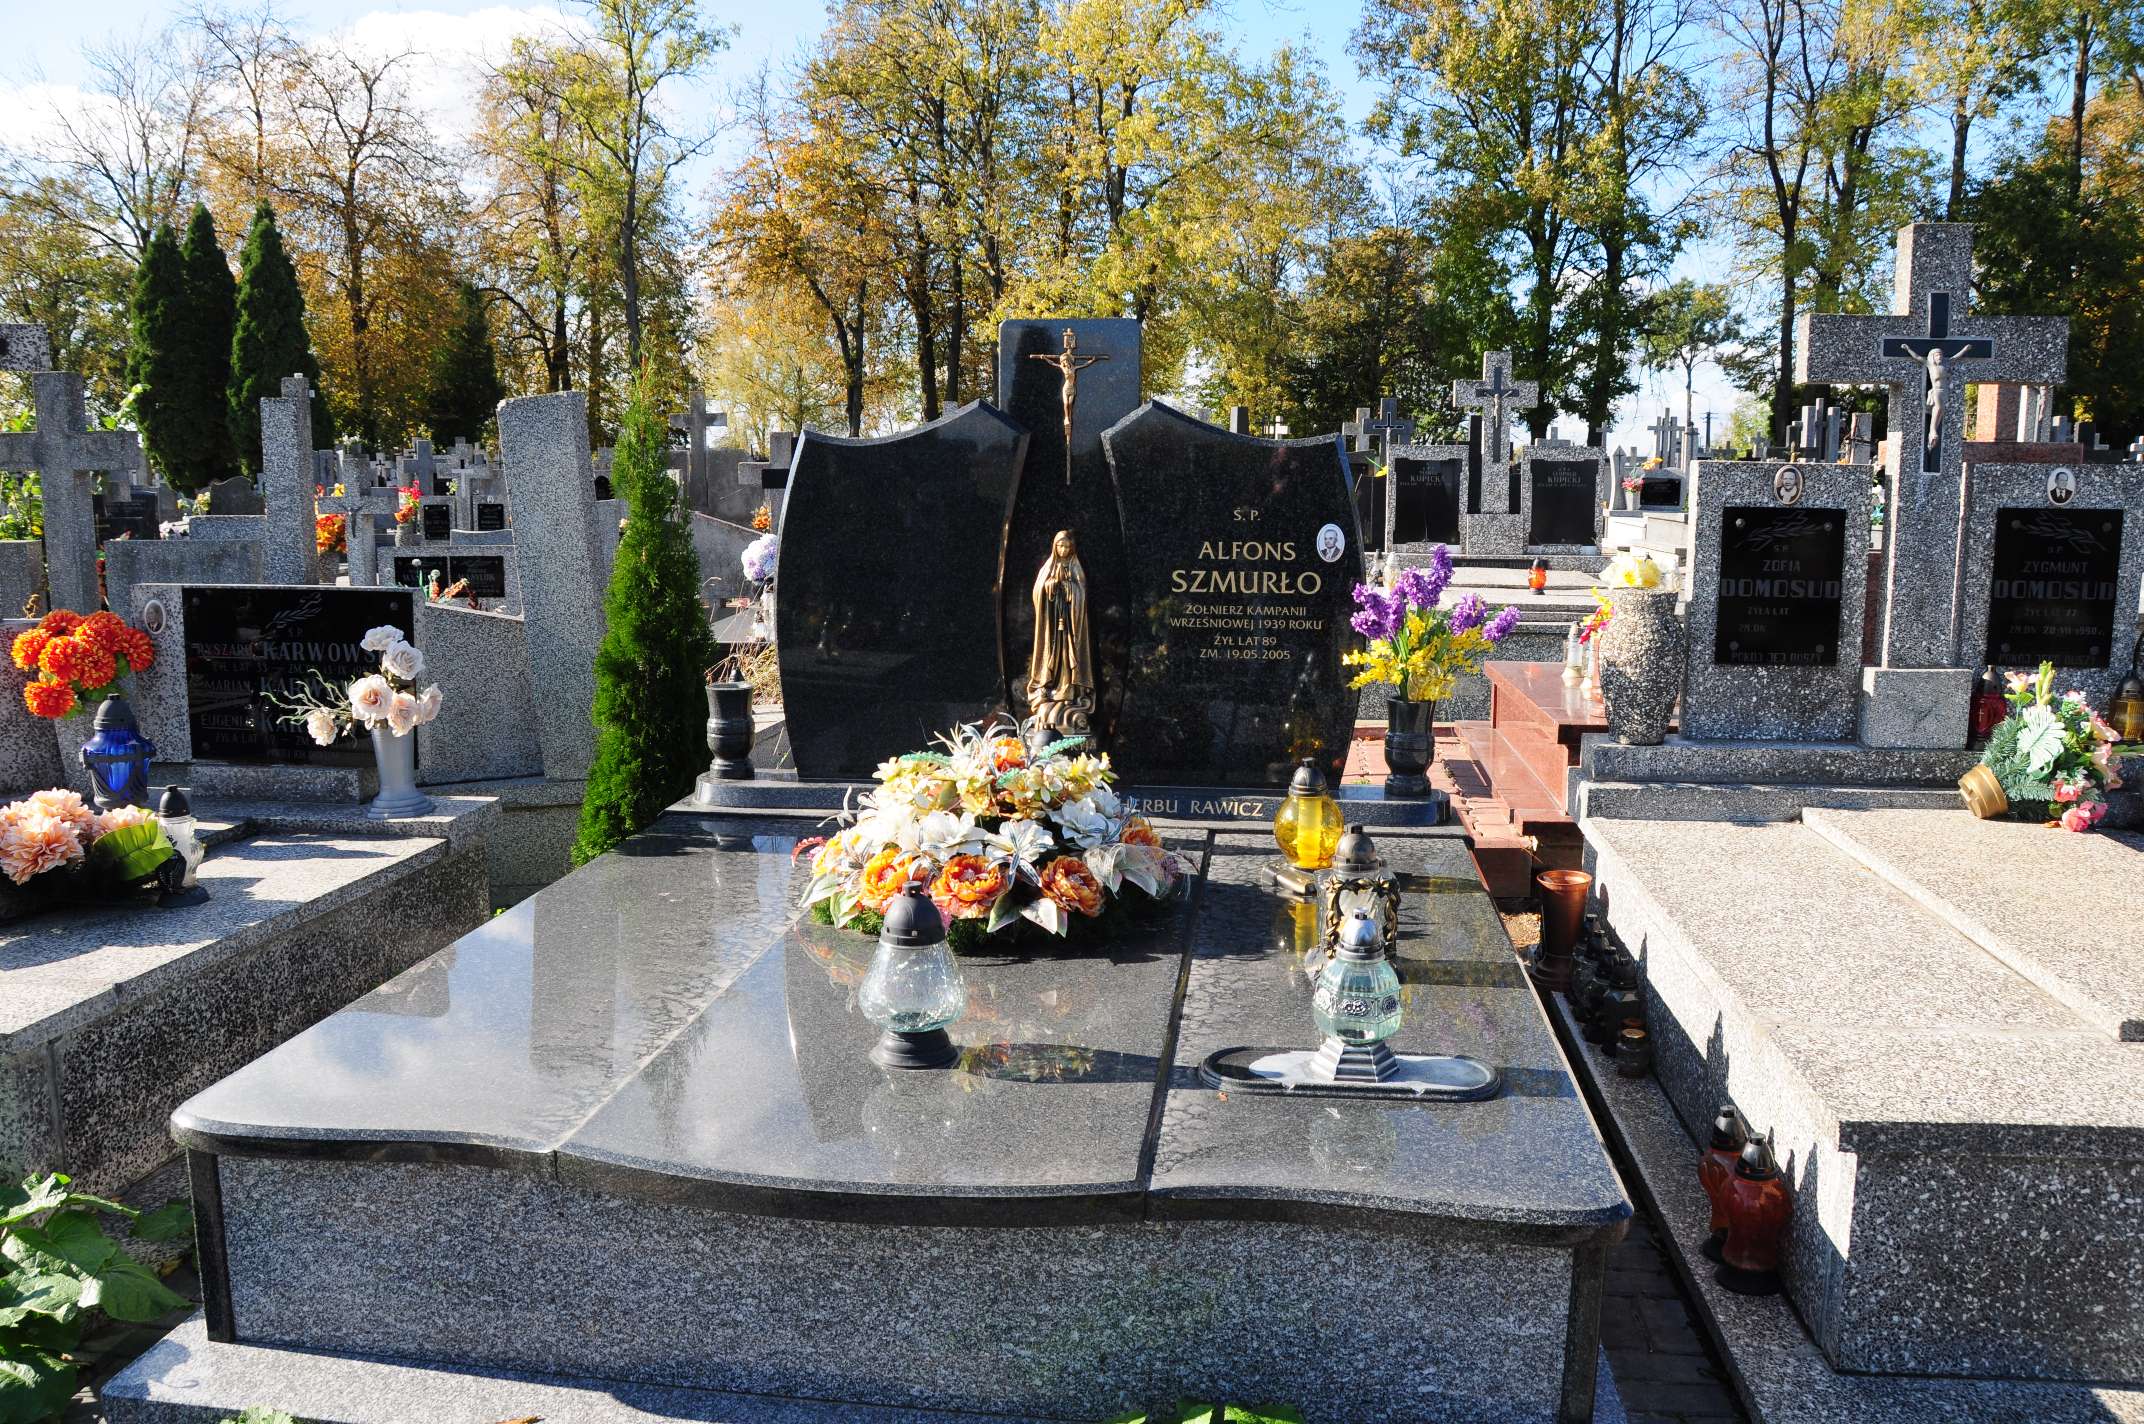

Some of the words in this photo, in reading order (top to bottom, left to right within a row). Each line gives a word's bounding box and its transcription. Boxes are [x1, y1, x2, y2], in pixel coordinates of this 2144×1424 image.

[1197, 541, 1297, 561] ALFONS
[1762, 559, 1801, 573] ZOFIA
[2022, 560, 2089, 574] ZYGMUNT
[1171, 569, 1323, 595] SZMURŁO
[1720, 577, 1841, 599] DOMOSUD
[1993, 579, 2115, 601] DOMOSUD
[1186, 602, 1244, 616] ŻOŁNIERZ
[1247, 605, 1307, 617] KAMPANII
[1170, 616, 1255, 631] WRZEŚNIOWEJ
[1259, 618, 1287, 630] 1939
[1289, 619, 1323, 631] ROKU
[1214, 633, 1235, 646] ŻYŁ
[1238, 635, 1259, 646] LAT
[1262, 636, 1277, 647] 89
[263, 641, 384, 663] KARWOWS
[1200, 648, 1222, 659] ZM.
[1227, 649, 1291, 660] 19.05.2005
[205, 679, 251, 692] MARIAN
[1190, 799, 1264, 817] RAWICZ
